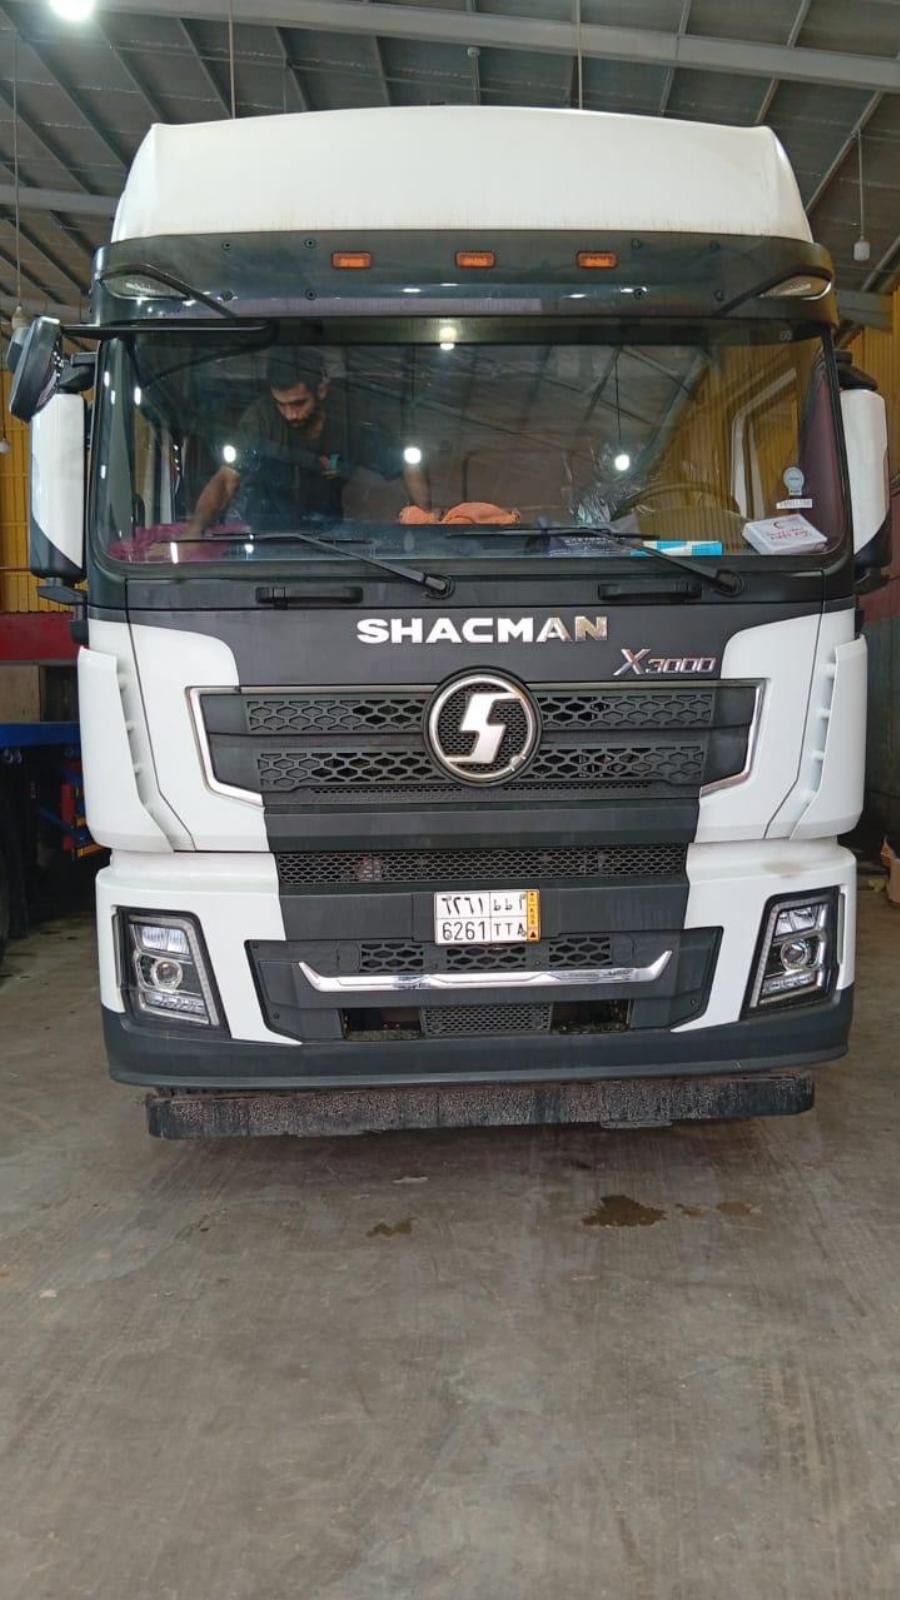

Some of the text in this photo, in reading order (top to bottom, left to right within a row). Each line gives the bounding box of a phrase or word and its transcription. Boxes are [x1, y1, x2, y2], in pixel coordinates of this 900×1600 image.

[356, 616, 609, 644] SHACMAN
[613, 648, 717, 676] X3000
[442, 920, 485, 941] 6261
